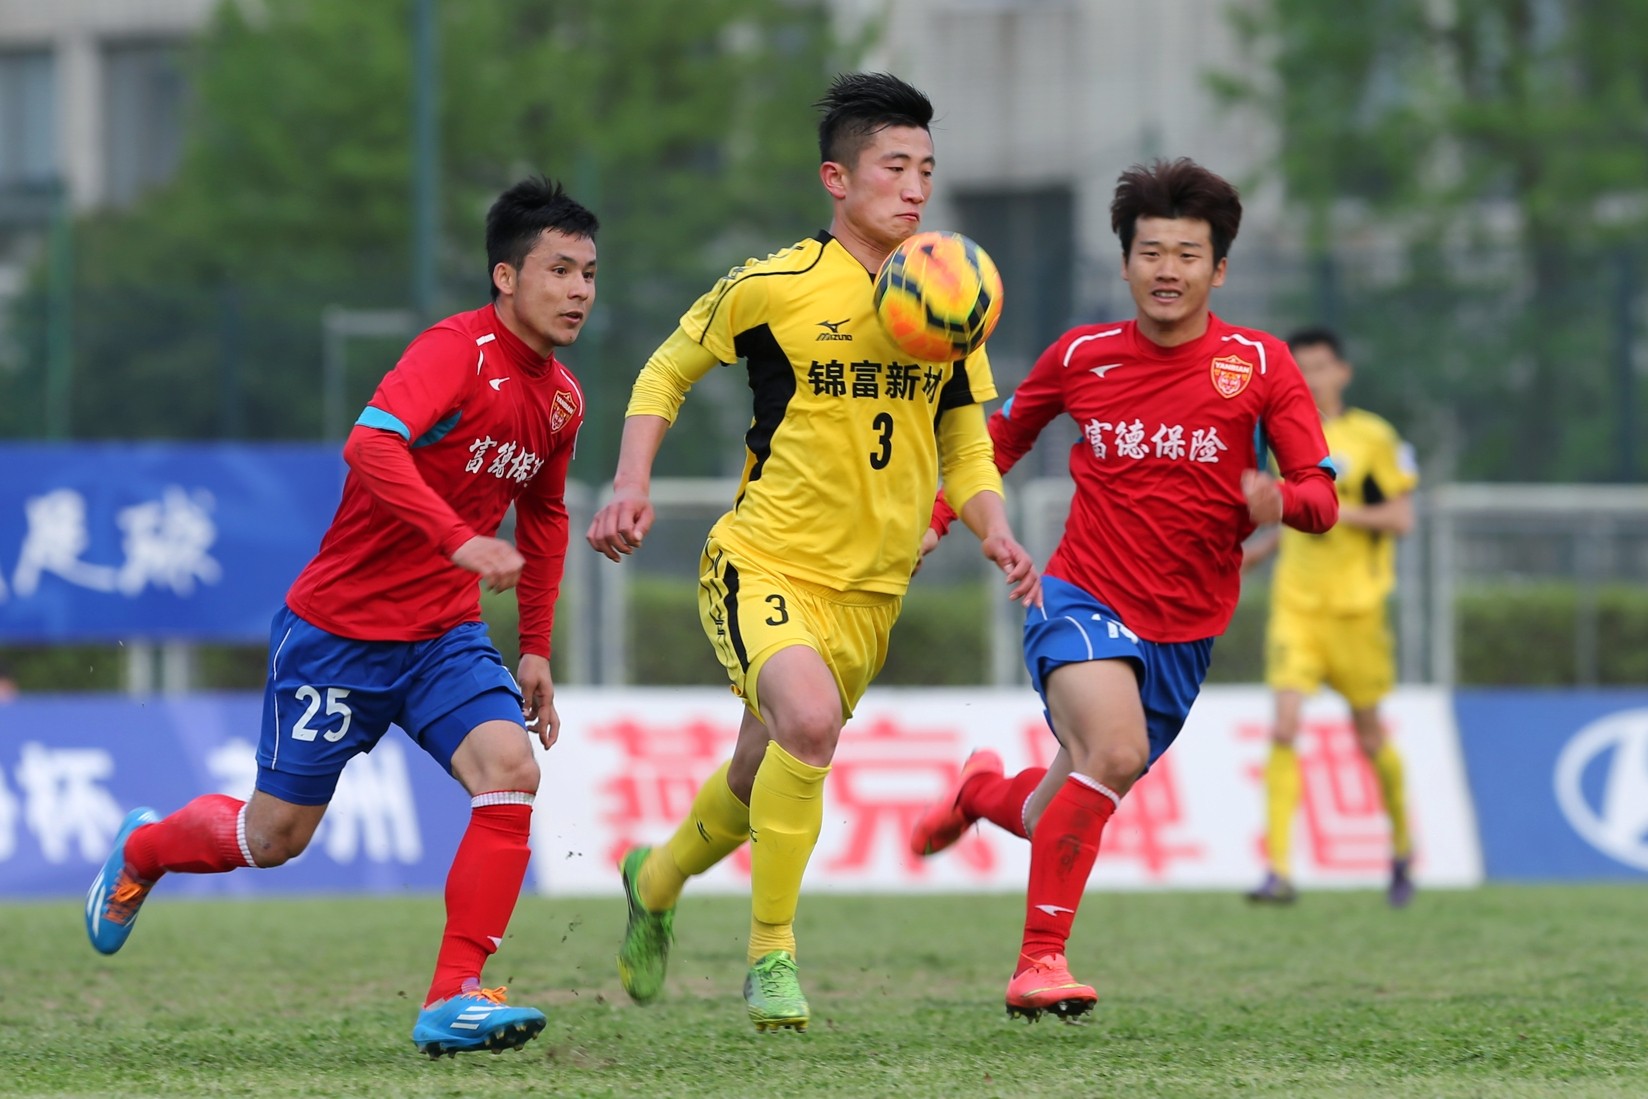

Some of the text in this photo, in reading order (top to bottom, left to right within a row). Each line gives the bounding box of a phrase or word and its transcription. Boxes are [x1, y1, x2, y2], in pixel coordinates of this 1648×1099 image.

[807, 359, 943, 404] 锦富新材
[870, 412, 893, 470] 3
[1084, 418, 1228, 463] 富德保险
[765, 594, 789, 626] 3
[291, 684, 352, 743] 25
